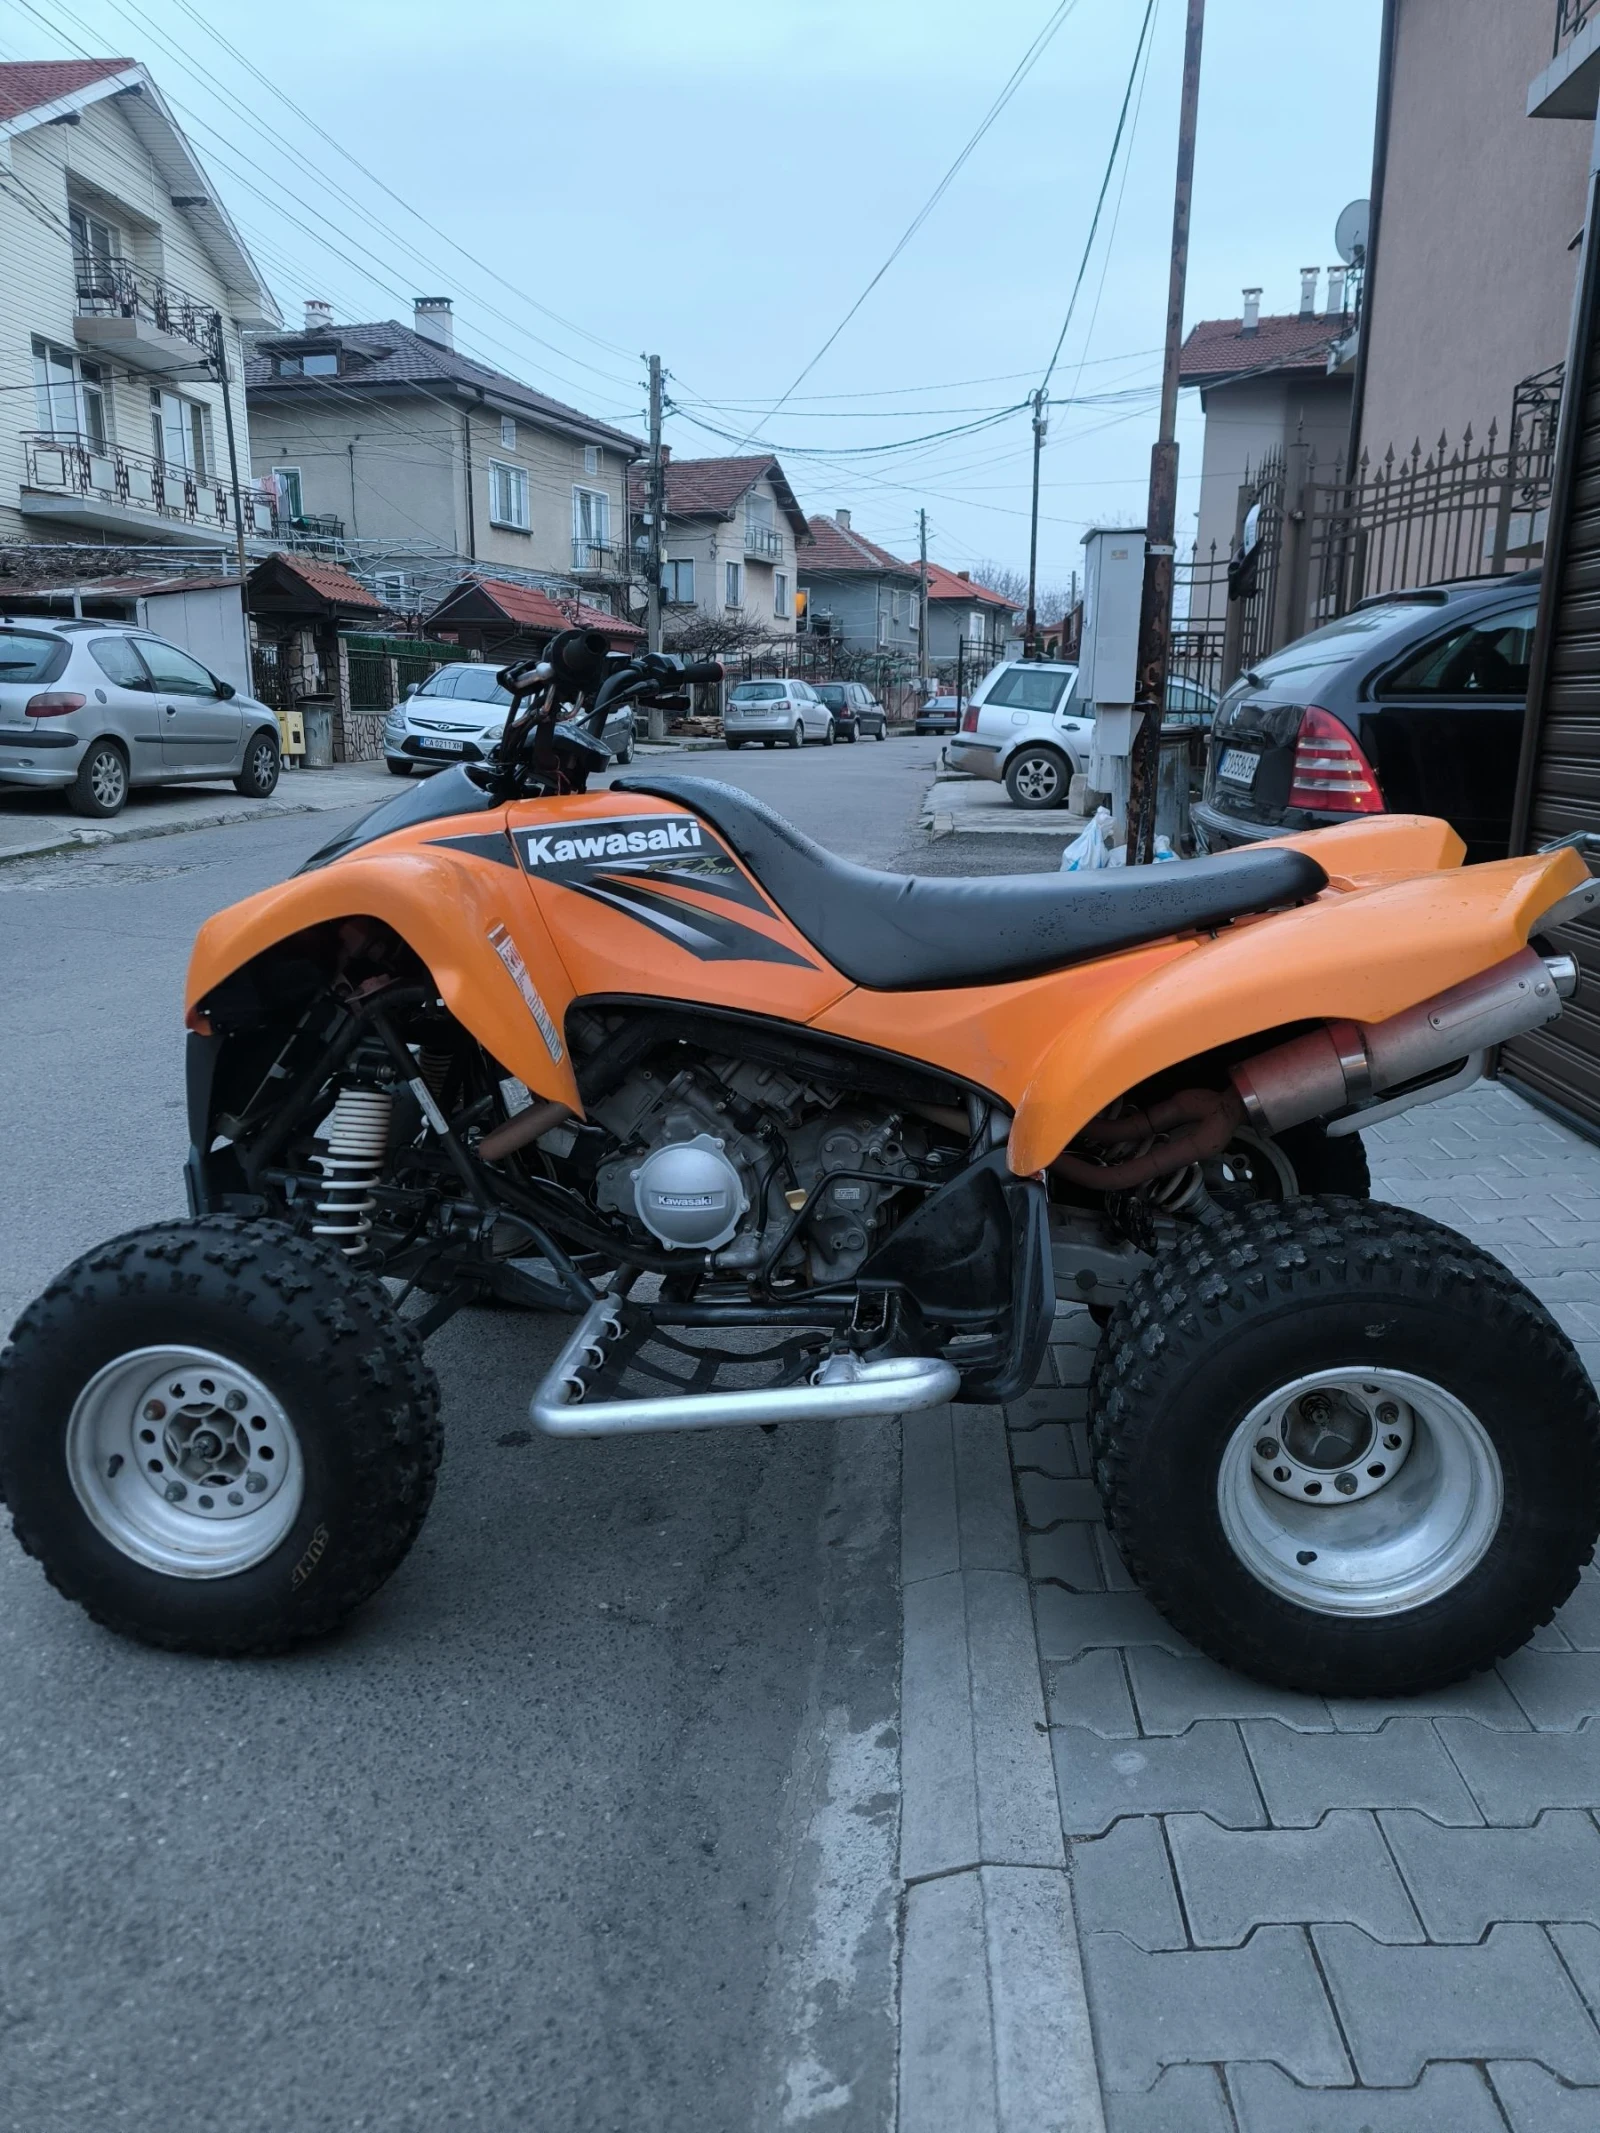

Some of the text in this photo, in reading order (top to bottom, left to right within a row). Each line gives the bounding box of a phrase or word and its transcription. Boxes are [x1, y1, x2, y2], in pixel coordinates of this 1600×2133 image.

[527, 821, 702, 866] Kawasaki
[644, 856, 721, 873] KFX
[658, 1195, 712, 1206] Kawasaki
